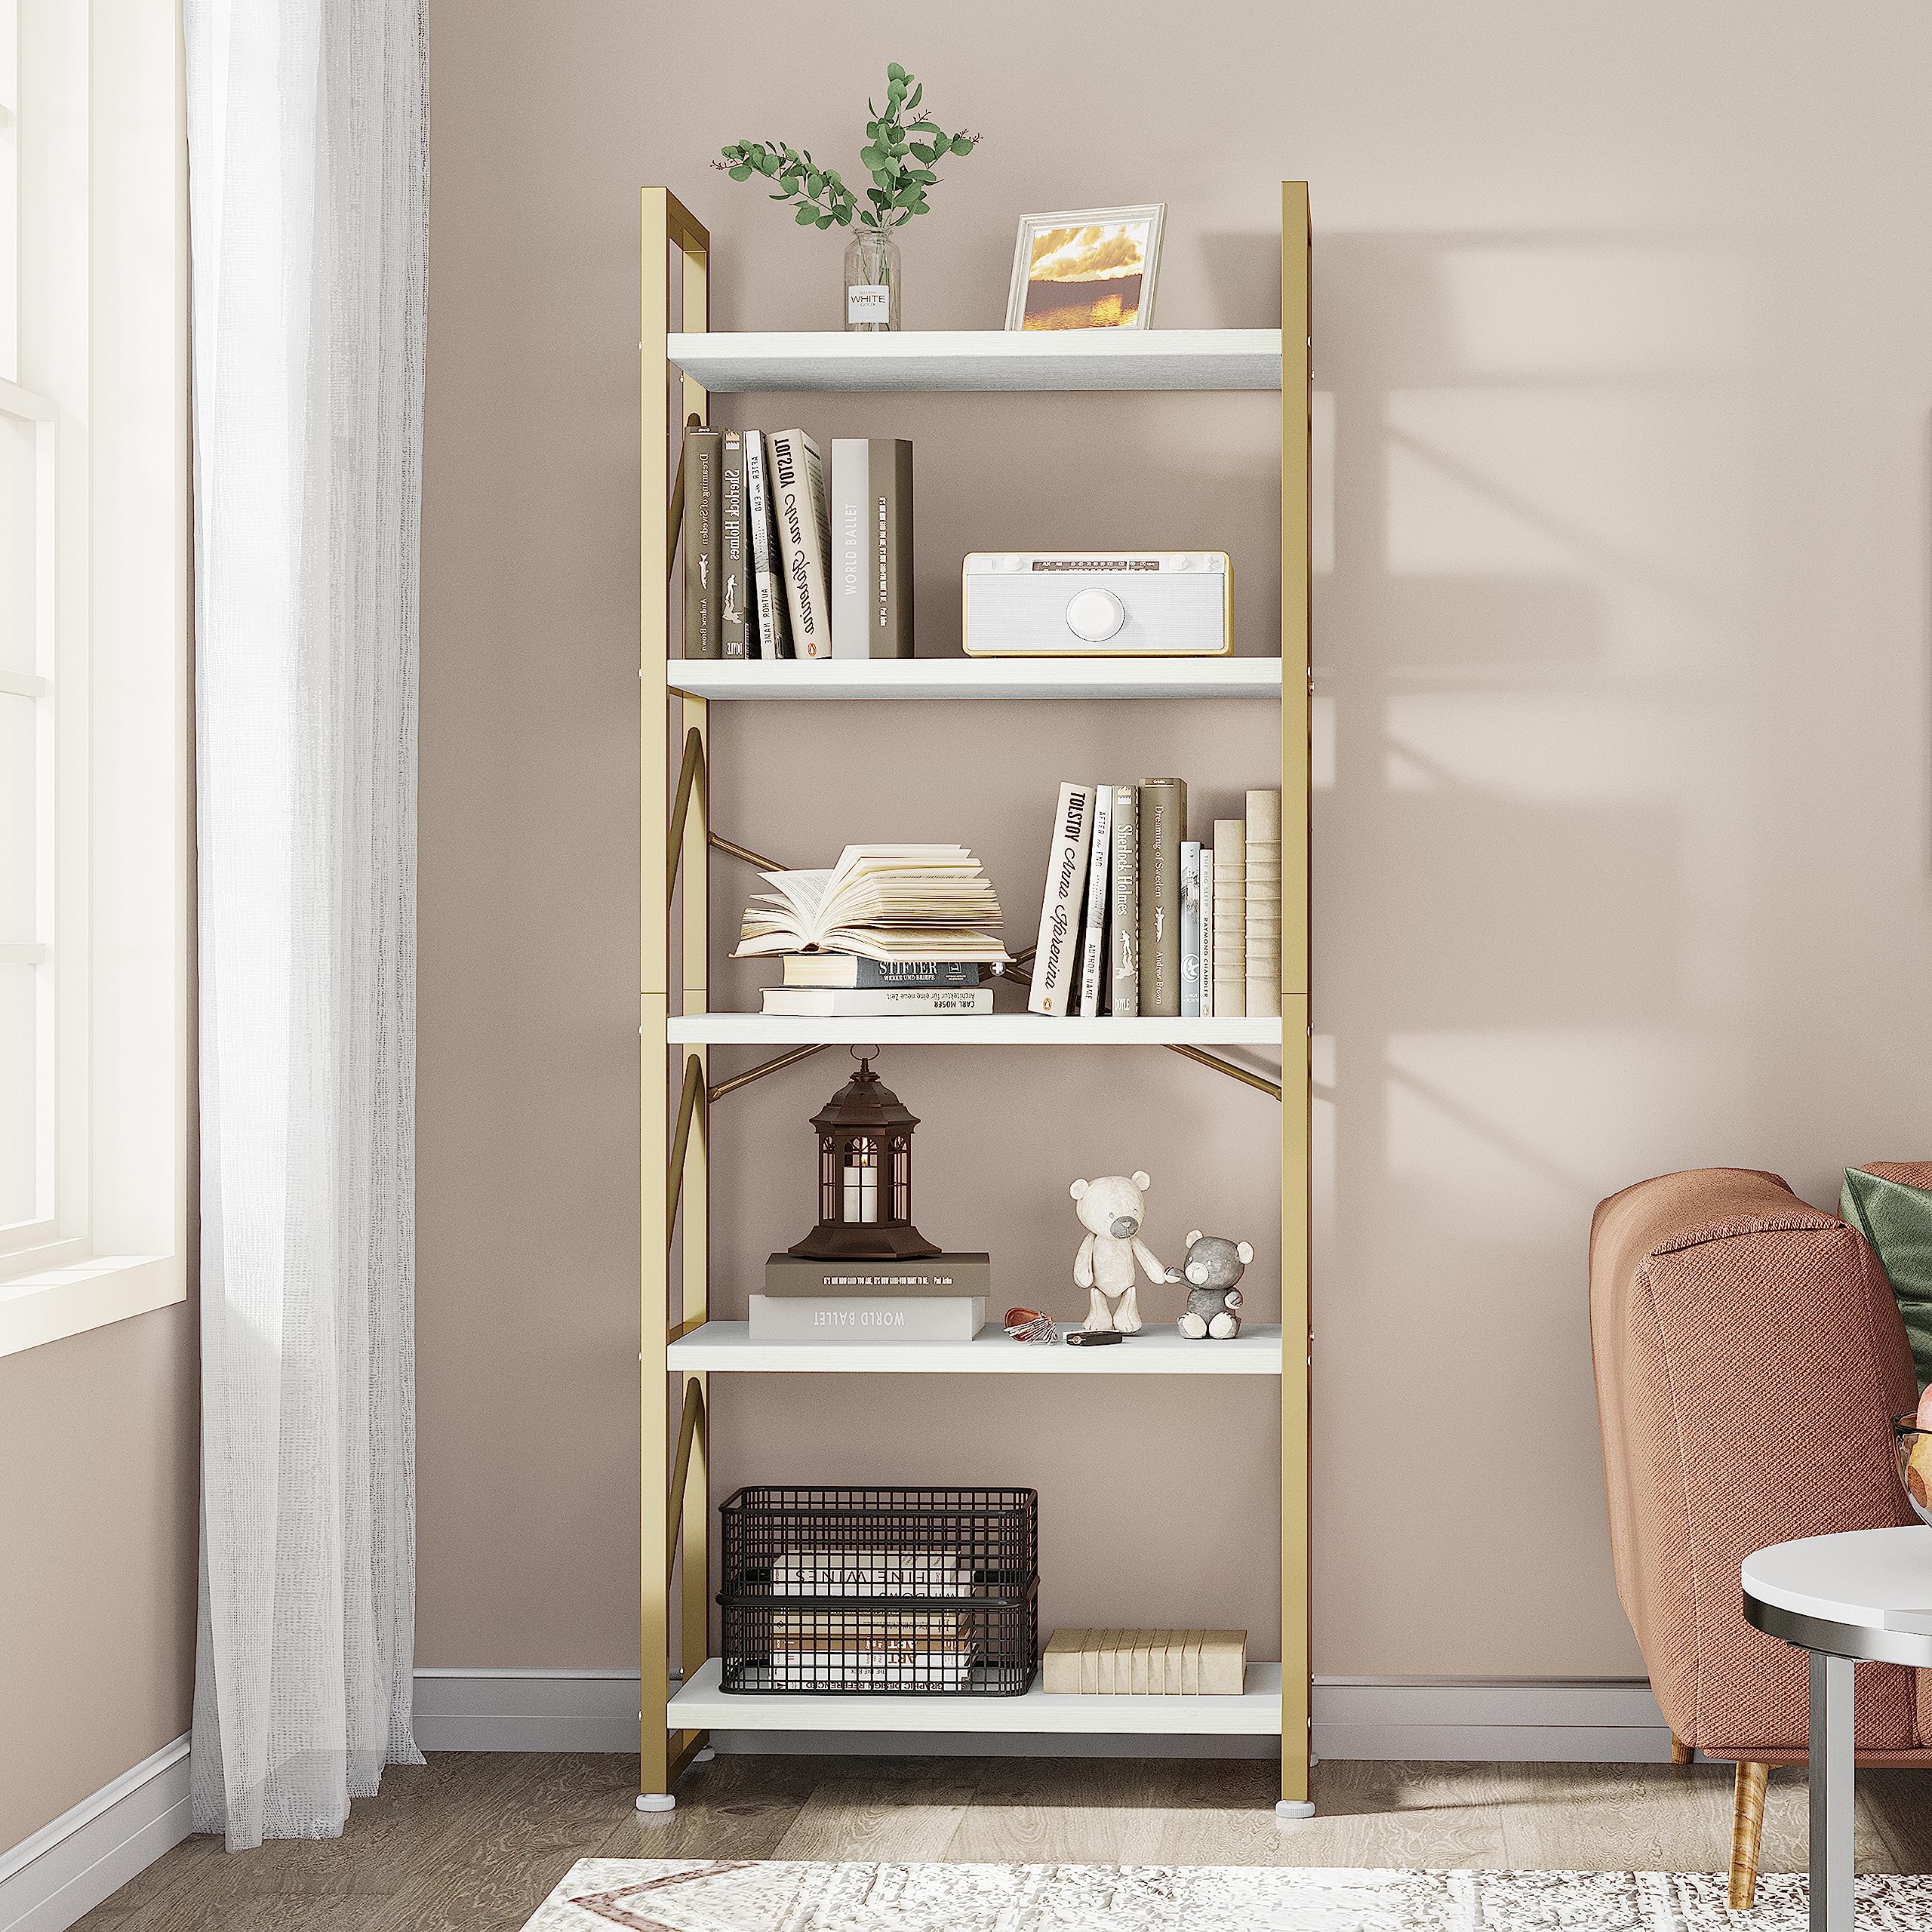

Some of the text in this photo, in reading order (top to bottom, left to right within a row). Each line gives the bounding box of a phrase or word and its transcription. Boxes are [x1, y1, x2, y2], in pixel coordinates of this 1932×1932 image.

[851, 295, 886, 303] WHITE
[844, 503, 857, 595] WORLD BALLET
[1097, 811, 1106, 835] AFTER
[1153, 804, 1164, 897] Dreaming of Sweden
[1095, 851, 1103, 867] END
[1117, 825, 1134, 915] Sherlock Holmes
[1044, 792, 1086, 990] TOLSTOY Anna Karenina
[878, 961, 938, 975] STIFTER
[1085, 943, 1096, 1000] AUTHOR NAME
[1155, 951, 1164, 1004] Andrew Brown
[1115, 998, 1131, 1011] DOYLE
[813, 1311, 905, 1326] WORLD BALLET
[795, 1571, 867, 1583] WINES
[878, 1571, 925, 1583] FINE
[887, 1639, 918, 1650] ART
[888, 1653, 918, 1664] ART
[805, 1681, 943, 1690] GRAPHIC DESIGN REFERENCED
